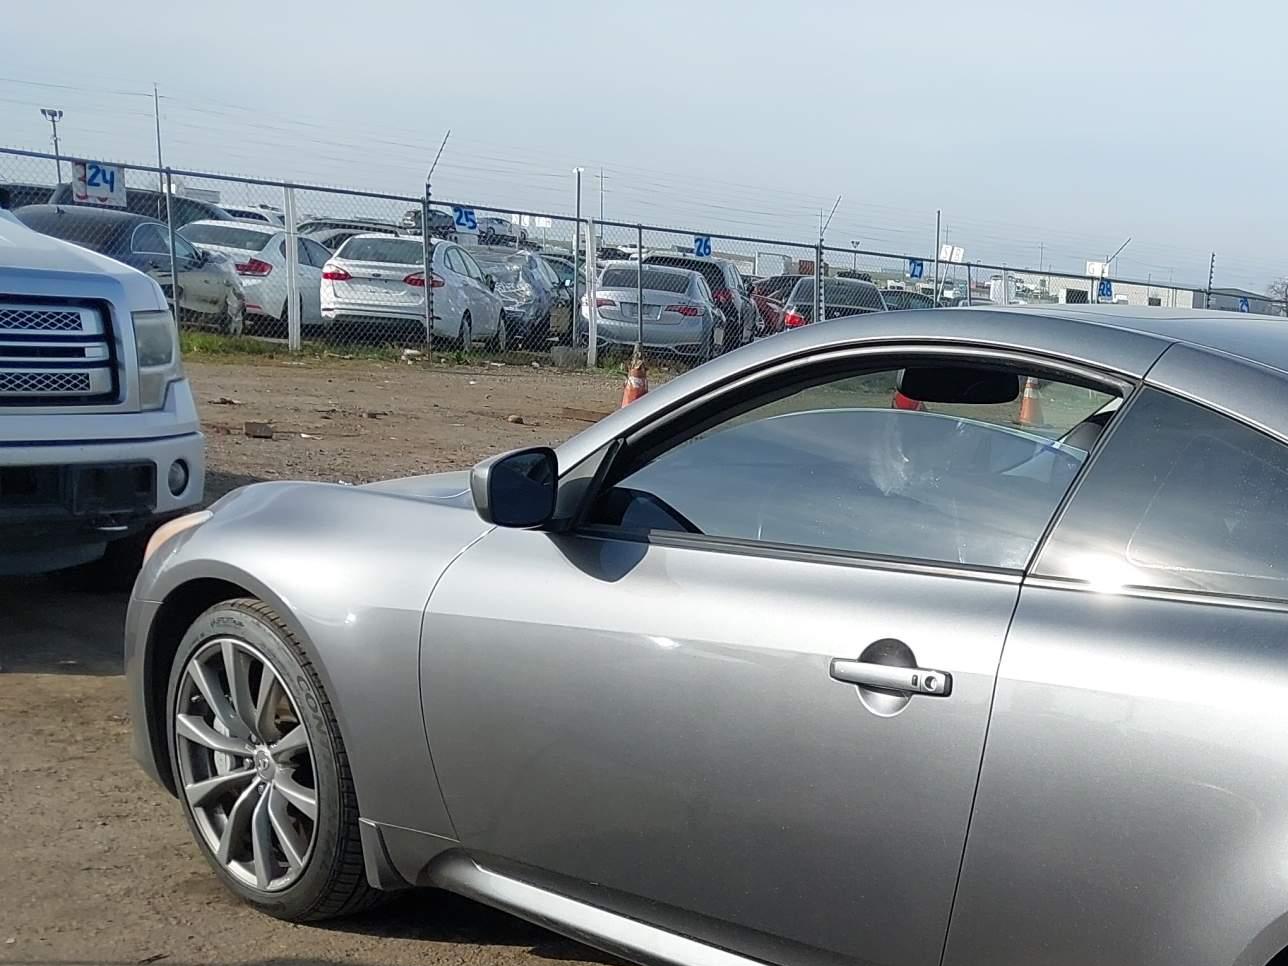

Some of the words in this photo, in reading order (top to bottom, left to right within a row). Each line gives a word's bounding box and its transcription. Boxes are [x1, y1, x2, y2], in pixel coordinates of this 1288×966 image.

[87, 164, 115, 193] 24
[453, 206, 477, 230] 25
[694, 237, 712, 257] 26
[909, 260, 924, 279] 27
[1098, 280, 1112, 297] 28
